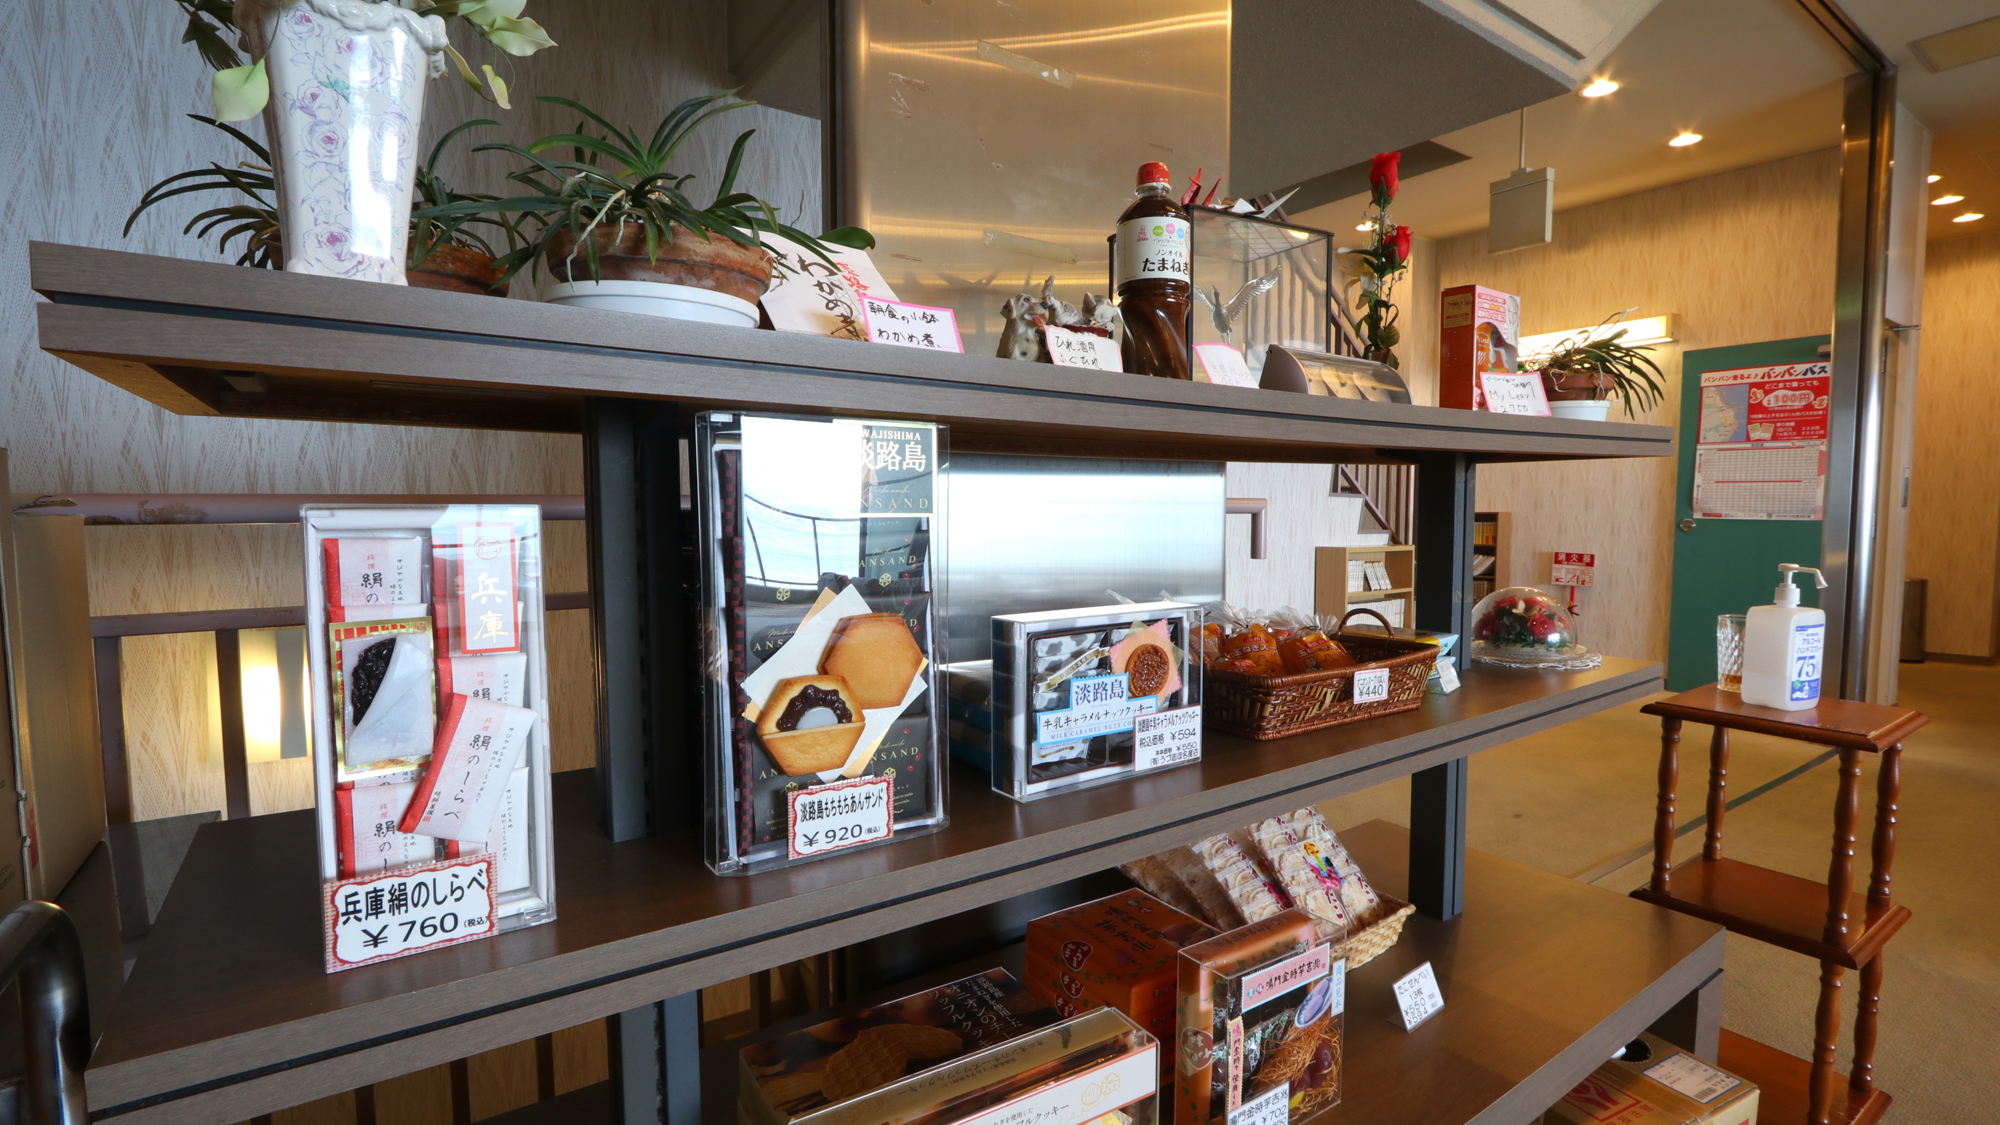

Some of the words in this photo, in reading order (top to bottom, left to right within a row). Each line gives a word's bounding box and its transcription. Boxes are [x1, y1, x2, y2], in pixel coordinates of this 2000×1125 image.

[1155, 249, 1183, 258] ノンオイル
[1142, 257, 1189, 276] たまねぎ
[1760, 364, 1829, 380] バンバンバス
[1764, 380, 1819, 389] どこまで乗っても
[861, 429, 922, 441] WAJISHIMA
[861, 498, 929, 509] NSAND
[471, 571, 510, 645] 兵庫
[1074, 678, 1125, 706] 淡路島
[1358, 684, 1384, 698] ¥440
[1042, 703, 1154, 731] 牛乳キャラメルナッツクッキー
[1050, 731, 1068, 741] MILK
[1070, 726, 1101, 737] CARAMEL
[1104, 722, 1121, 731] NUTS
[1139, 733, 1165, 749] 税込価格
[1170, 727, 1197, 742] ¥594
[870, 746, 919, 763] NSAND
[1176, 741, 1198, 752] ¥550
[443, 734, 492, 820] 絹のしらべ
[800, 787, 884, 823] 淡路島もちもちあんサンド
[802, 824, 863, 848] ¥920
[340, 868, 486, 926] 兵庫絹のしらべ
[361, 912, 459, 949] ¥760
[463, 915, 489, 928] (税込)
[1265, 957, 1321, 991] 鳴門金時芋吉兆
[1397, 968, 1430, 996] たこせんべい
[965, 980, 1023, 1028] たまねぎを使用した
[1409, 987, 1424, 1001] 13枚
[1403, 997, 1426, 1016] ¥550
[1407, 1006, 1429, 1026] ¥594
[1229, 1088, 1289, 1125] 鳴門金時芋吉兆
[1261, 1104, 1287, 1124] ¥702
